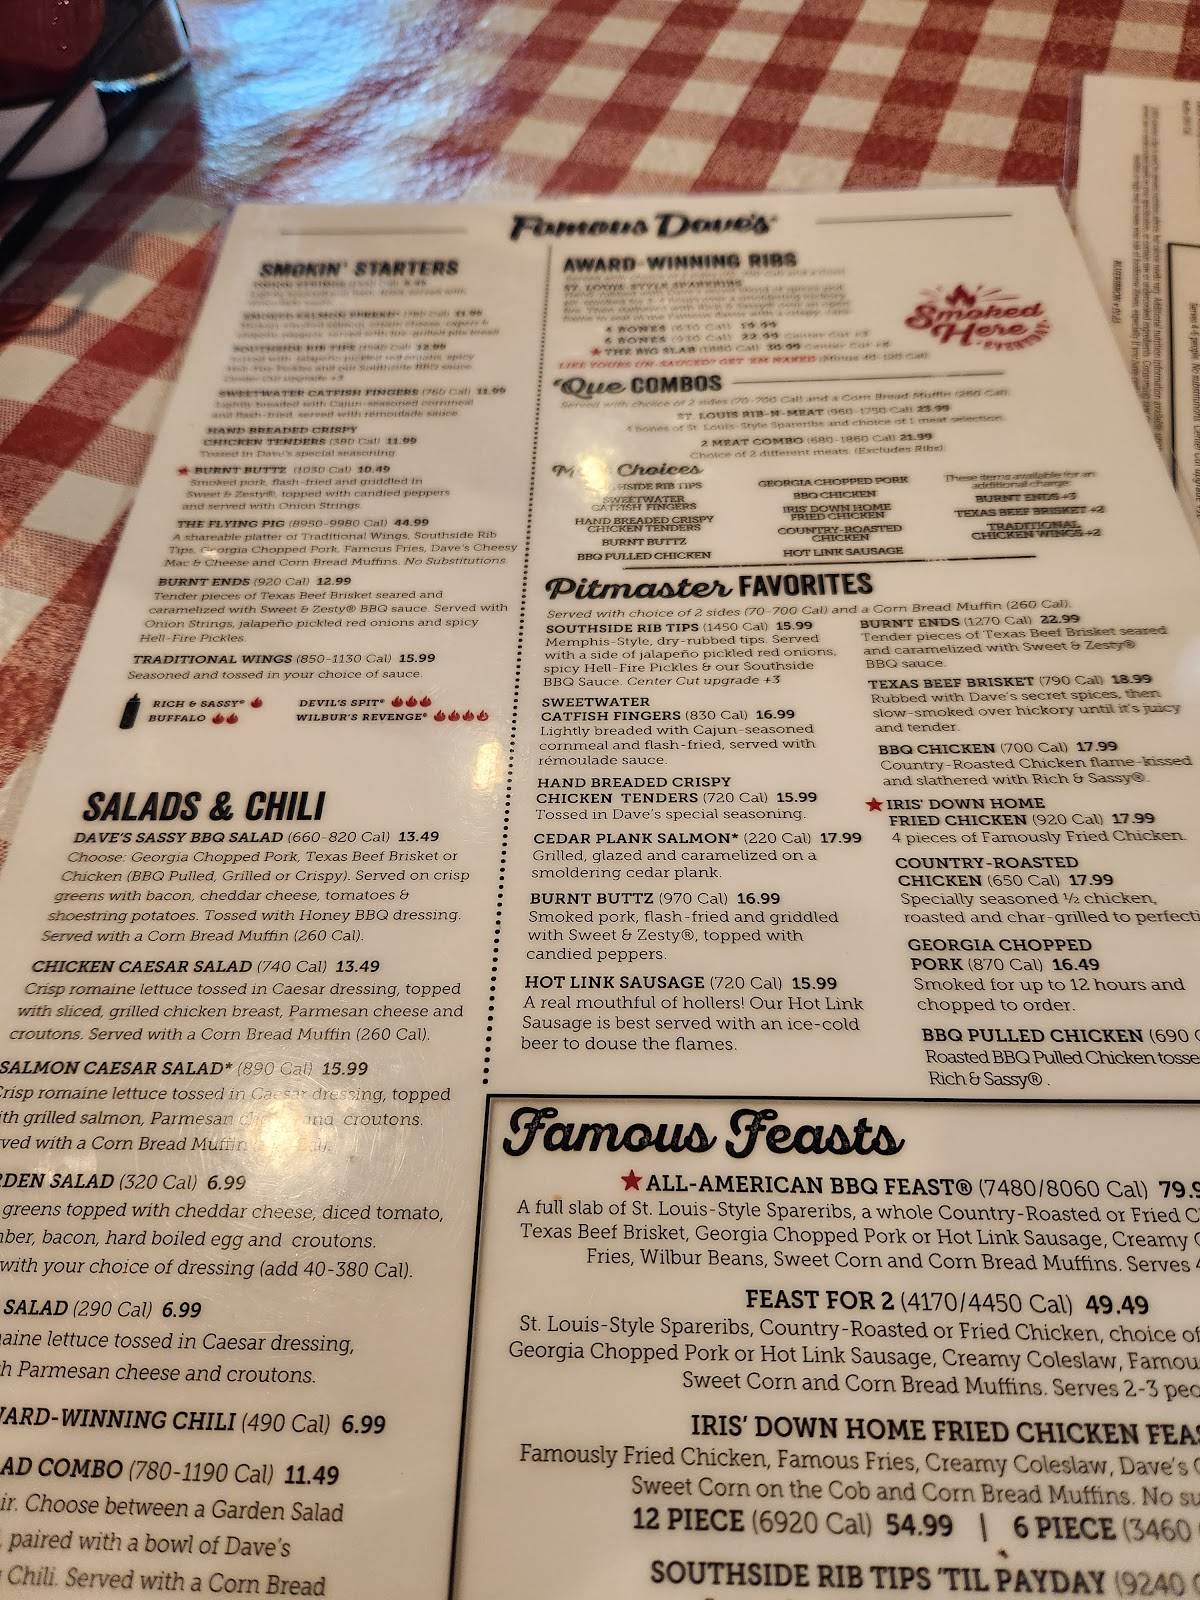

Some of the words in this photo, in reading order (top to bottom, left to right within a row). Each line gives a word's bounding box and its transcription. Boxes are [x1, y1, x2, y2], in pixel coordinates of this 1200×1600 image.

[509, 214, 649, 242] Famous
[354, 259, 459, 277] STARTERS
[904, 302, 1043, 330] Smoked
[931, 322, 1027, 346] Here
[630, 374, 722, 394] COMBOS
[194, 466, 241, 474] BURNT
[243, 465, 287, 474] BUTTZ
[328, 465, 351, 473] Cal)
[357, 465, 390, 473] 10.49
[617, 462, 704, 477] Choices
[758, 479, 813, 487] GEORGIA
[813, 477, 873, 486] CHOPPED
[874, 476, 909, 484] PORK
[793, 491, 818, 500] BBQ
[819, 490, 877, 499] CHICKEN
[177, 520, 206, 528] THE
[207, 519, 258, 528] FLYING
[261, 519, 285, 528] PIG
[364, 519, 387, 527] Cal)
[393, 518, 429, 526] 44.99
[777, 524, 903, 536] COUNTRY-ROASTED
[601, 537, 645, 546] BURNT
[646, 537, 687, 546] BUTTZ
[811, 533, 870, 543] CHICKEN
[577, 552, 603, 560] BBQ
[604, 552, 653, 560] PULLED
[653, 551, 712, 560] CHICKEN
[783, 548, 811, 557] HOT
[813, 547, 844, 556] LINK
[845, 546, 904, 556] SAUSAGE
[157, 577, 210, 586] BURNT
[211, 577, 250, 586] ENDS
[253, 577, 281, 586] (920
[285, 577, 309, 586] Cal)
[316, 577, 352, 585] 12.99
[545, 577, 733, 600] Pitmaster
[739, 572, 874, 597] FAVORITES
[546, 624, 633, 634] SOUTHSIDE
[637, 623, 662, 632] RIB
[665, 623, 699, 632] TIPS
[703, 622, 738, 632] (1450
[742, 622, 768, 631] Cal)
[776, 621, 813, 630] 15.99
[860, 618, 913, 629] BURNT
[917, 617, 960, 627] ENDS
[964, 616, 1000, 627] (1270
[1004, 616, 1032, 625] Cal)
[1040, 614, 1080, 624] 22.99
[133, 655, 237, 664] TRADITIONAL
[241, 654, 293, 664] WINGS
[296, 654, 361, 664] (850-1130
[365, 654, 391, 663] Cal)
[399, 653, 435, 663] 15.99
[127, 670, 190, 679] Seasoned
[193, 670, 219, 679] and
[222, 670, 264, 679] tossed
[267, 670, 280, 679] in
[283, 671, 315, 680] your
[317, 669, 362, 680] choice
[365, 669, 380, 679] of
[381, 671, 423, 679] sauce.
[867, 679, 919, 689] TEXAS
[922, 678, 962, 688] BEEF
[965, 676, 1034, 687] BRISKET
[1039, 675, 1071, 687] (790
[1074, 675, 1103, 685] Cal)
[1111, 674, 1153, 684] 18.99
[148, 714, 206, 722] BUFFALO
[296, 713, 358, 721] WILBUR'S
[82, 791, 202, 821] SALADS
[208, 791, 234, 821] &
[245, 791, 326, 821] CHILI
[73, 832, 132, 843] DAVE'S
[135, 832, 187, 843] SASSY
[189, 832, 225, 843] BBQ
[228, 832, 283, 843] SALAD
[288, 831, 357, 843] (660-820
[361, 831, 389, 843] Cal)
[398, 831, 439, 842] 13.49
[534, 833, 590, 844] CEDAR
[596, 833, 652, 844] PLANK
[744, 832, 776, 844] (220
[781, 832, 811, 844] Cal)
[820, 832, 862, 843] 17.99
[908, 938, 995, 951] GEORGIA
[998, 939, 1092, 951] CHOPPED
[31, 960, 116, 973] CHICKEN
[118, 960, 189, 973] CAESAR
[193, 960, 252, 972] SALAD
[257, 960, 291, 973] (740
[296, 960, 327, 973] Cal)
[335, 960, 380, 972] 13.49
[910, 958, 964, 970] PORK
[968, 958, 1004, 972] (870
[1009, 958, 1042, 972] Cal)
[1052, 958, 1100, 971] 16.49
[913, 977, 986, 991] Smoked
[990, 977, 1014, 991] for
[1019, 981, 1043, 994] up
[1047, 979, 1065, 991] to
[1070, 978, 1090, 991] 12
[1092, 978, 1147, 991] hours
[1151, 977, 1186, 991] and
[522, 995, 535, 1008] A
[540, 995, 571, 1008] real
[576, 995, 656, 1008] mouthful
[661, 995, 677, 1008] of
[683, 996, 744, 1009] hollers!
[749, 996, 783, 1010] Our
[788, 996, 821, 1010] Hot
[825, 996, 864, 1010] Link
[502, 1106, 717, 1156] Famous
[725, 1108, 905, 1159] Feasts
[3, 1299, 68, 1316] SALAD
[73, 1300, 112, 1318] (290
[117, 1301, 152, 1319] Cal)
[162, 1301, 201, 1318] 6.99
[745, 1289, 819, 1309] FEAST
[825, 1290, 875, 1310] FOR
[881, 1291, 895, 1310] 2
[901, 1291, 1022, 1313] (4170/4450
[1029, 1294, 1072, 1316] Cal)
[1085, 1295, 1149, 1315] 49.49
[633, 1507, 660, 1530] 12
[667, 1507, 745, 1532] PIECE
[752, 1509, 818, 1535] (6920
[826, 1512, 872, 1537] Cal)
[886, 1513, 953, 1537] 54.99
[1013, 1515, 1030, 1539] 6
[1034, 1516, 1117, 1541] PIECE
